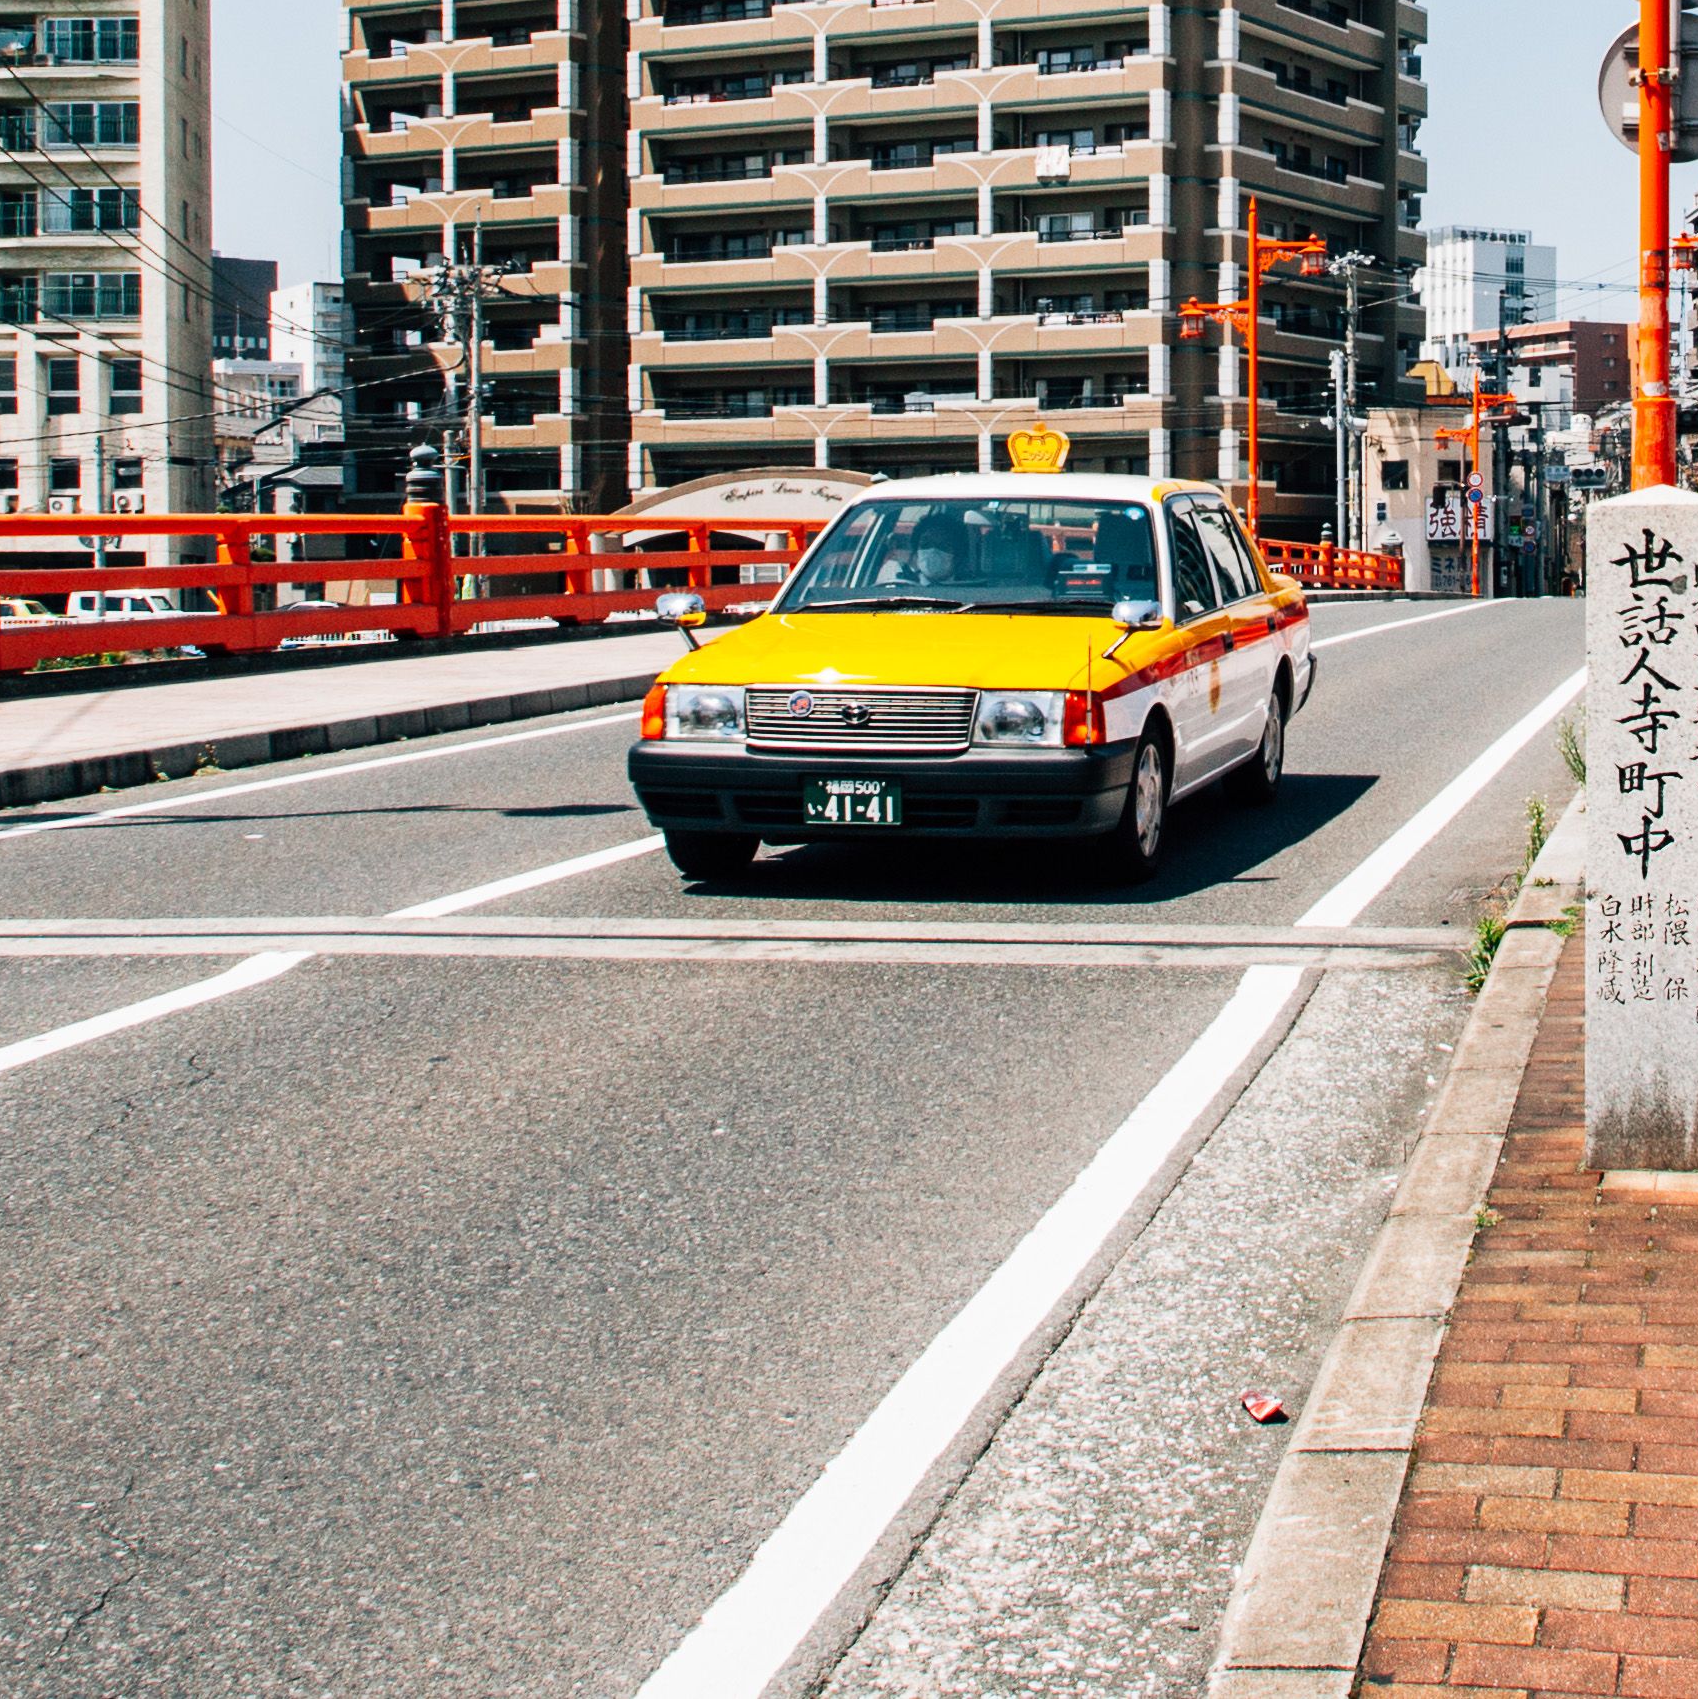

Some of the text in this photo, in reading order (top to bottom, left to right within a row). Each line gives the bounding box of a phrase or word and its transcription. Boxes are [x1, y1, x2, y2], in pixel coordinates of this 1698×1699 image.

[1609, 527, 1686, 880] 世話人寺町中
[824, 795, 893, 823] 41-41
[1600, 894, 1625, 944] 白水
